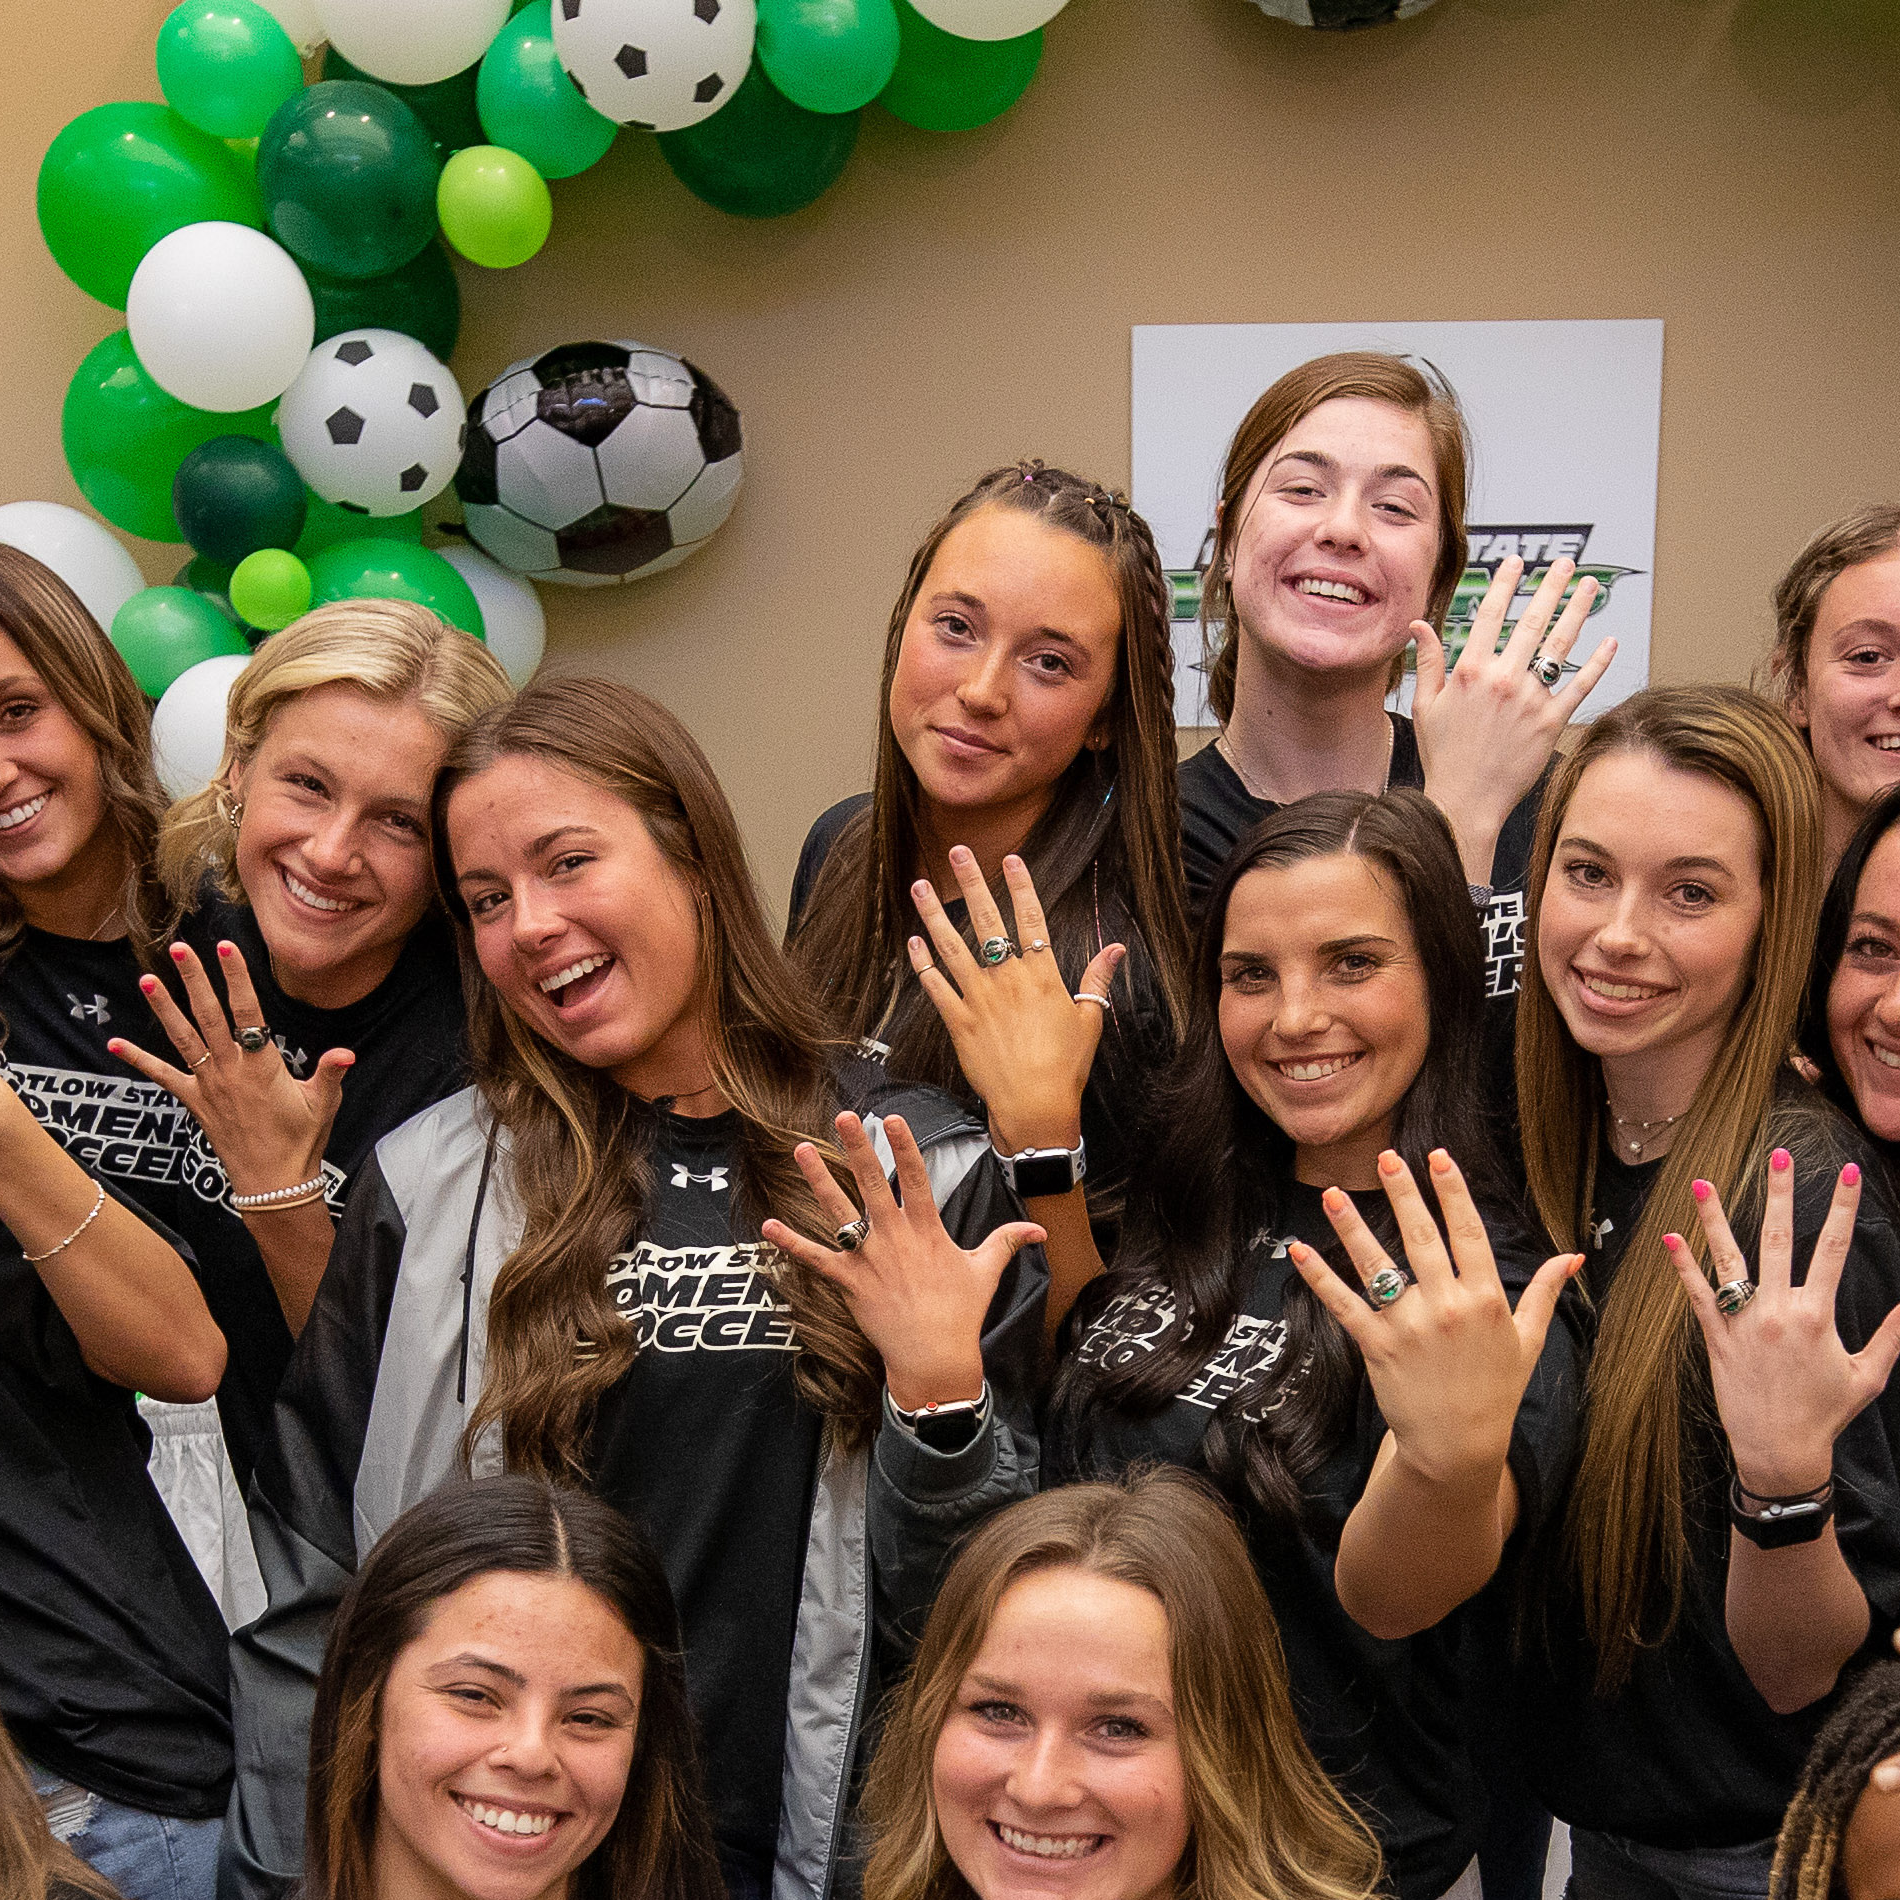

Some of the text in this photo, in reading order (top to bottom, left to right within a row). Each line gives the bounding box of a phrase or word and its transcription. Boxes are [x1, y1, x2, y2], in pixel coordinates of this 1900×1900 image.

[1465, 533, 1581, 562] TATE
[122, 1086, 179, 1108] STA
[17, 1090, 186, 1147] OMEN
[607, 1248, 718, 1275] OTLOW
[605, 1270, 791, 1312] OMEN
